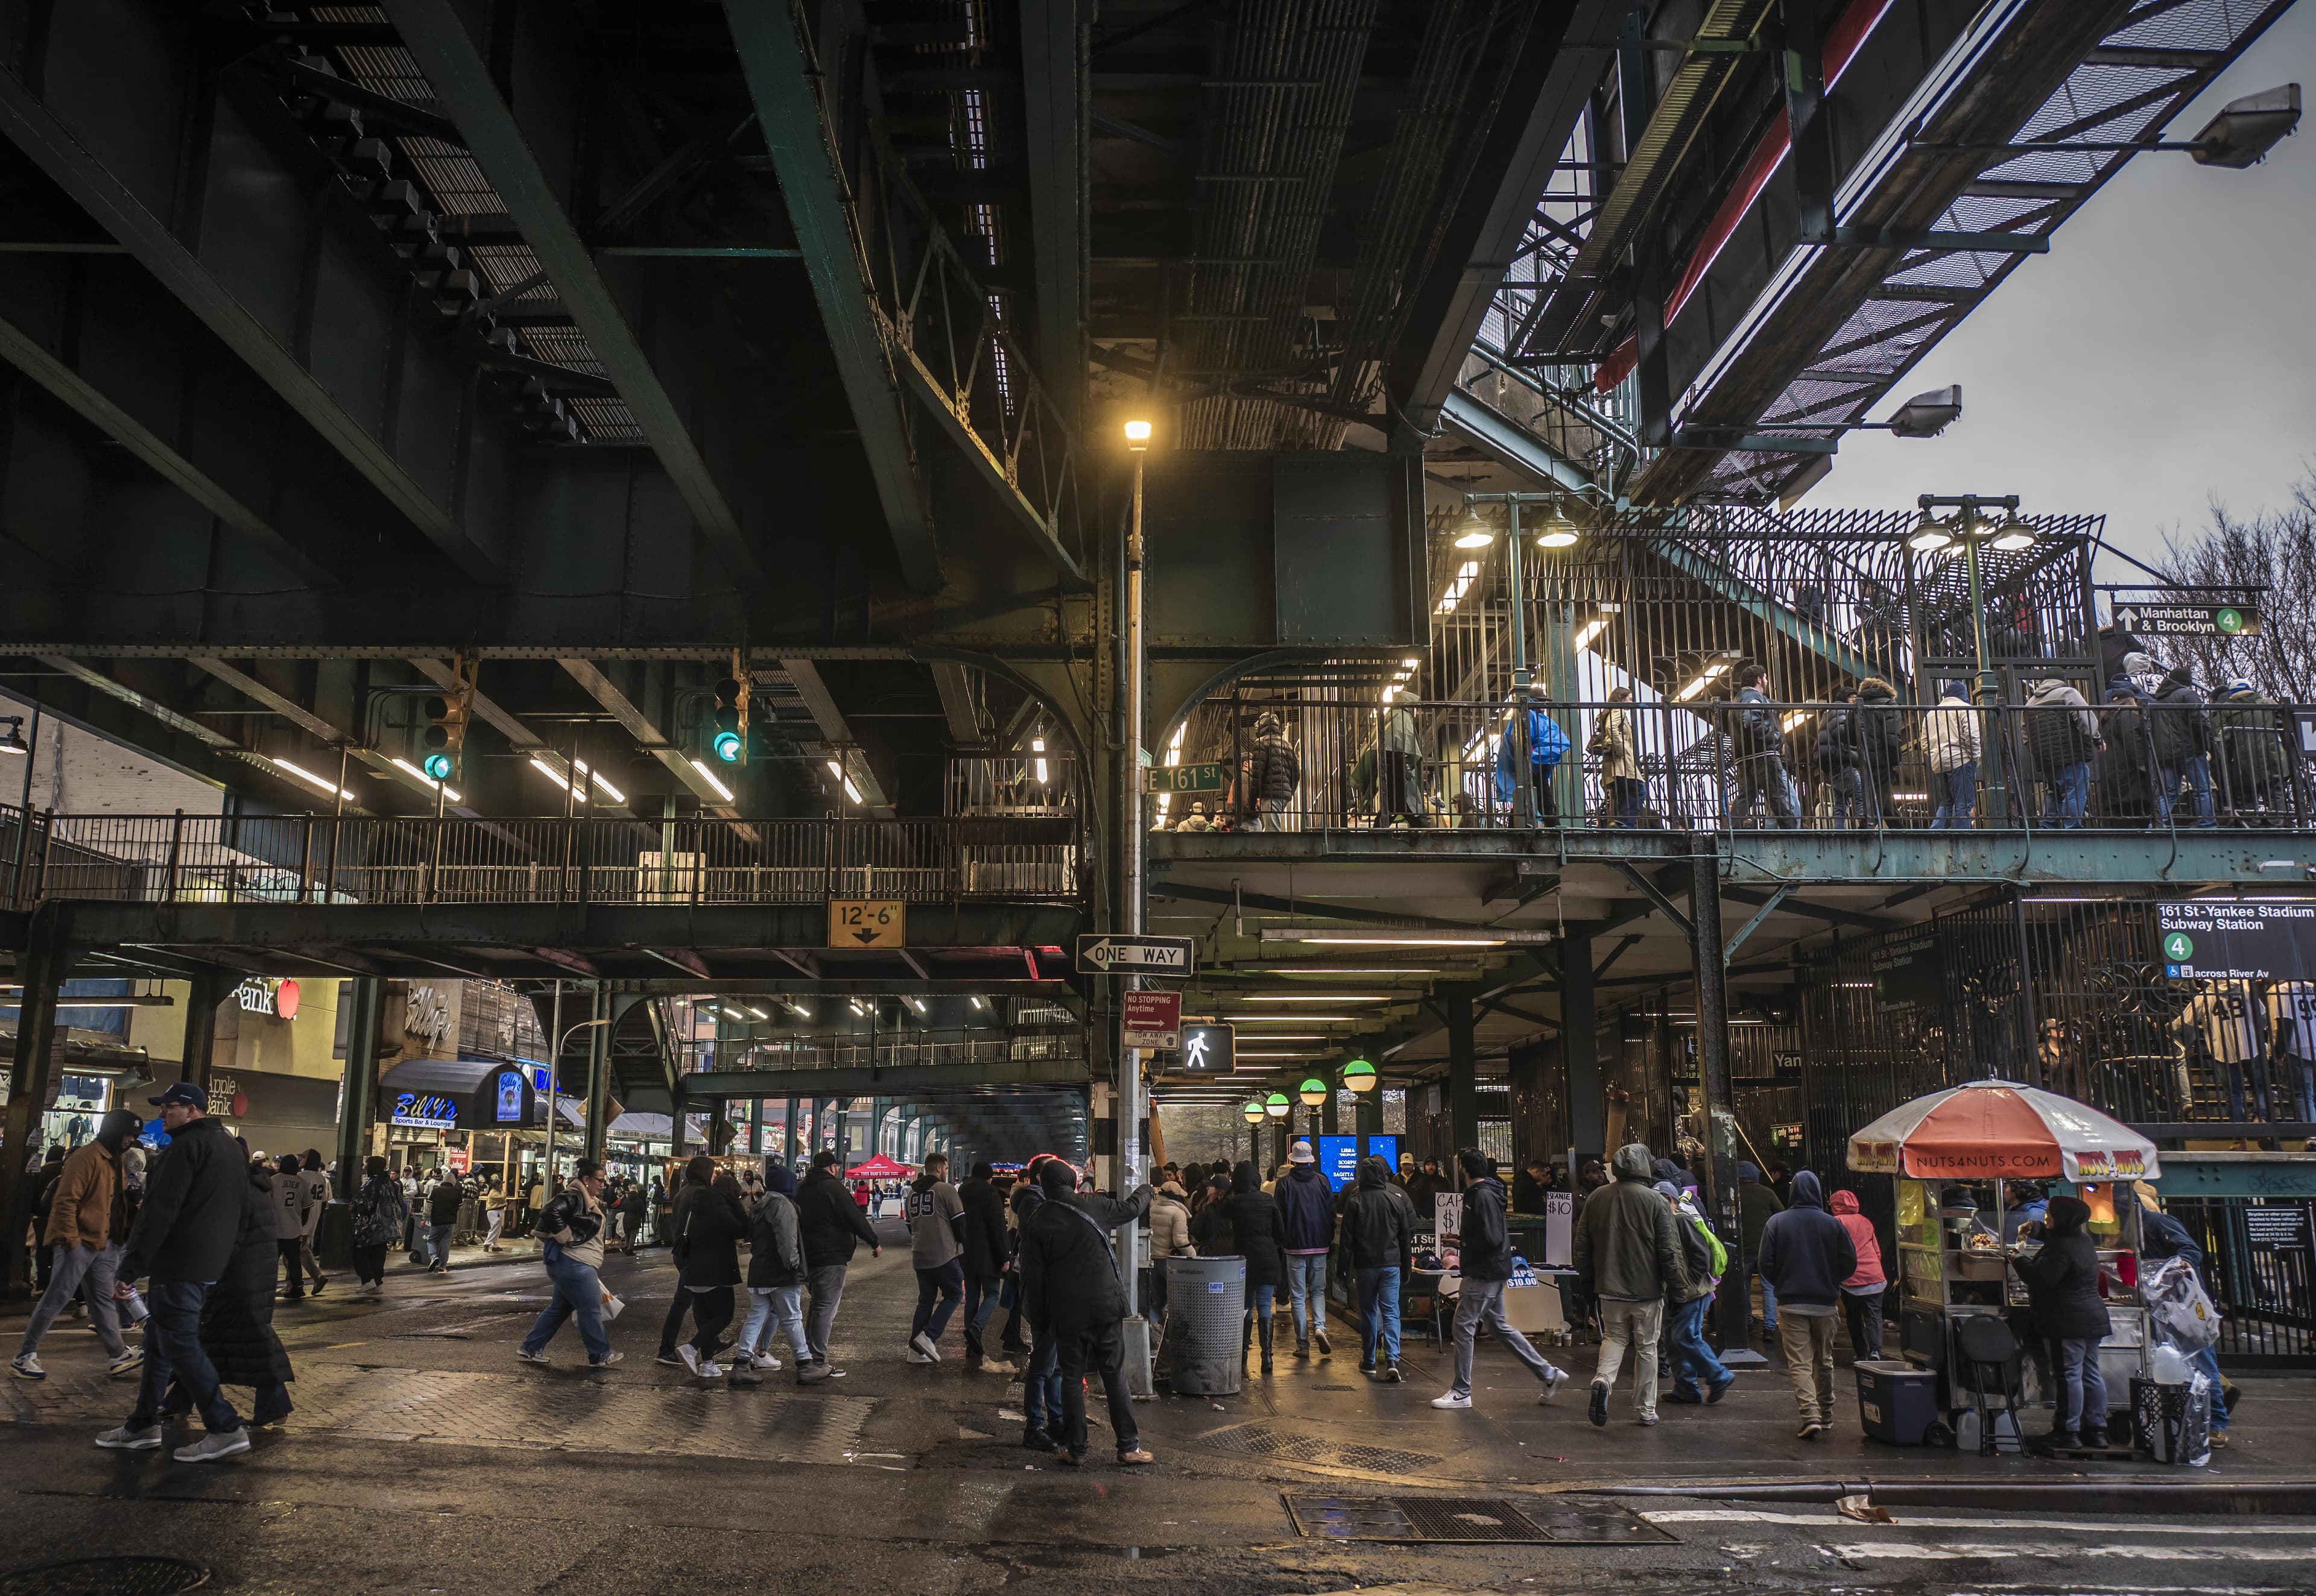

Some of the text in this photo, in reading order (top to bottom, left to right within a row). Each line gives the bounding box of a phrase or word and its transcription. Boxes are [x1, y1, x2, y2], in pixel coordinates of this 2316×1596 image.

[2140, 607, 2209, 619] Manhattan
[2223, 613, 2235, 626] 4
[2142, 620, 2215, 634] & Brooklyn
[1149, 766, 1217, 790] E 161 St
[2159, 906, 2180, 916] 161
[2258, 906, 2314, 918] Stadium
[2161, 918, 2264, 932] Subway Station
[1909, 939, 1933, 952] Stadium
[2171, 938, 2185, 955] 4
[1095, 947, 1177, 964] ONE WAY
[1873, 956, 1913, 971] Subway Station
[2229, 969, 2254, 978] River
[2256, 970, 2269, 978] Av
[1138, 996, 1171, 1005] STOPPING
[1127, 1005, 1154, 1014] Anytime
[1778, 1128, 1786, 1138] only
[1917, 1156, 2050, 1167] NUTS4NUTS.COM
[282, 1180, 299, 1189] JETER
[284, 1190, 295, 1207] 2
[311, 1184, 324, 1200] 42
[910, 1190, 935, 1219] 99
[1548, 1201, 1572, 1216] $10
[1511, 1269, 1534, 1278] APS
[1508, 1278, 1537, 1287] $10.00
